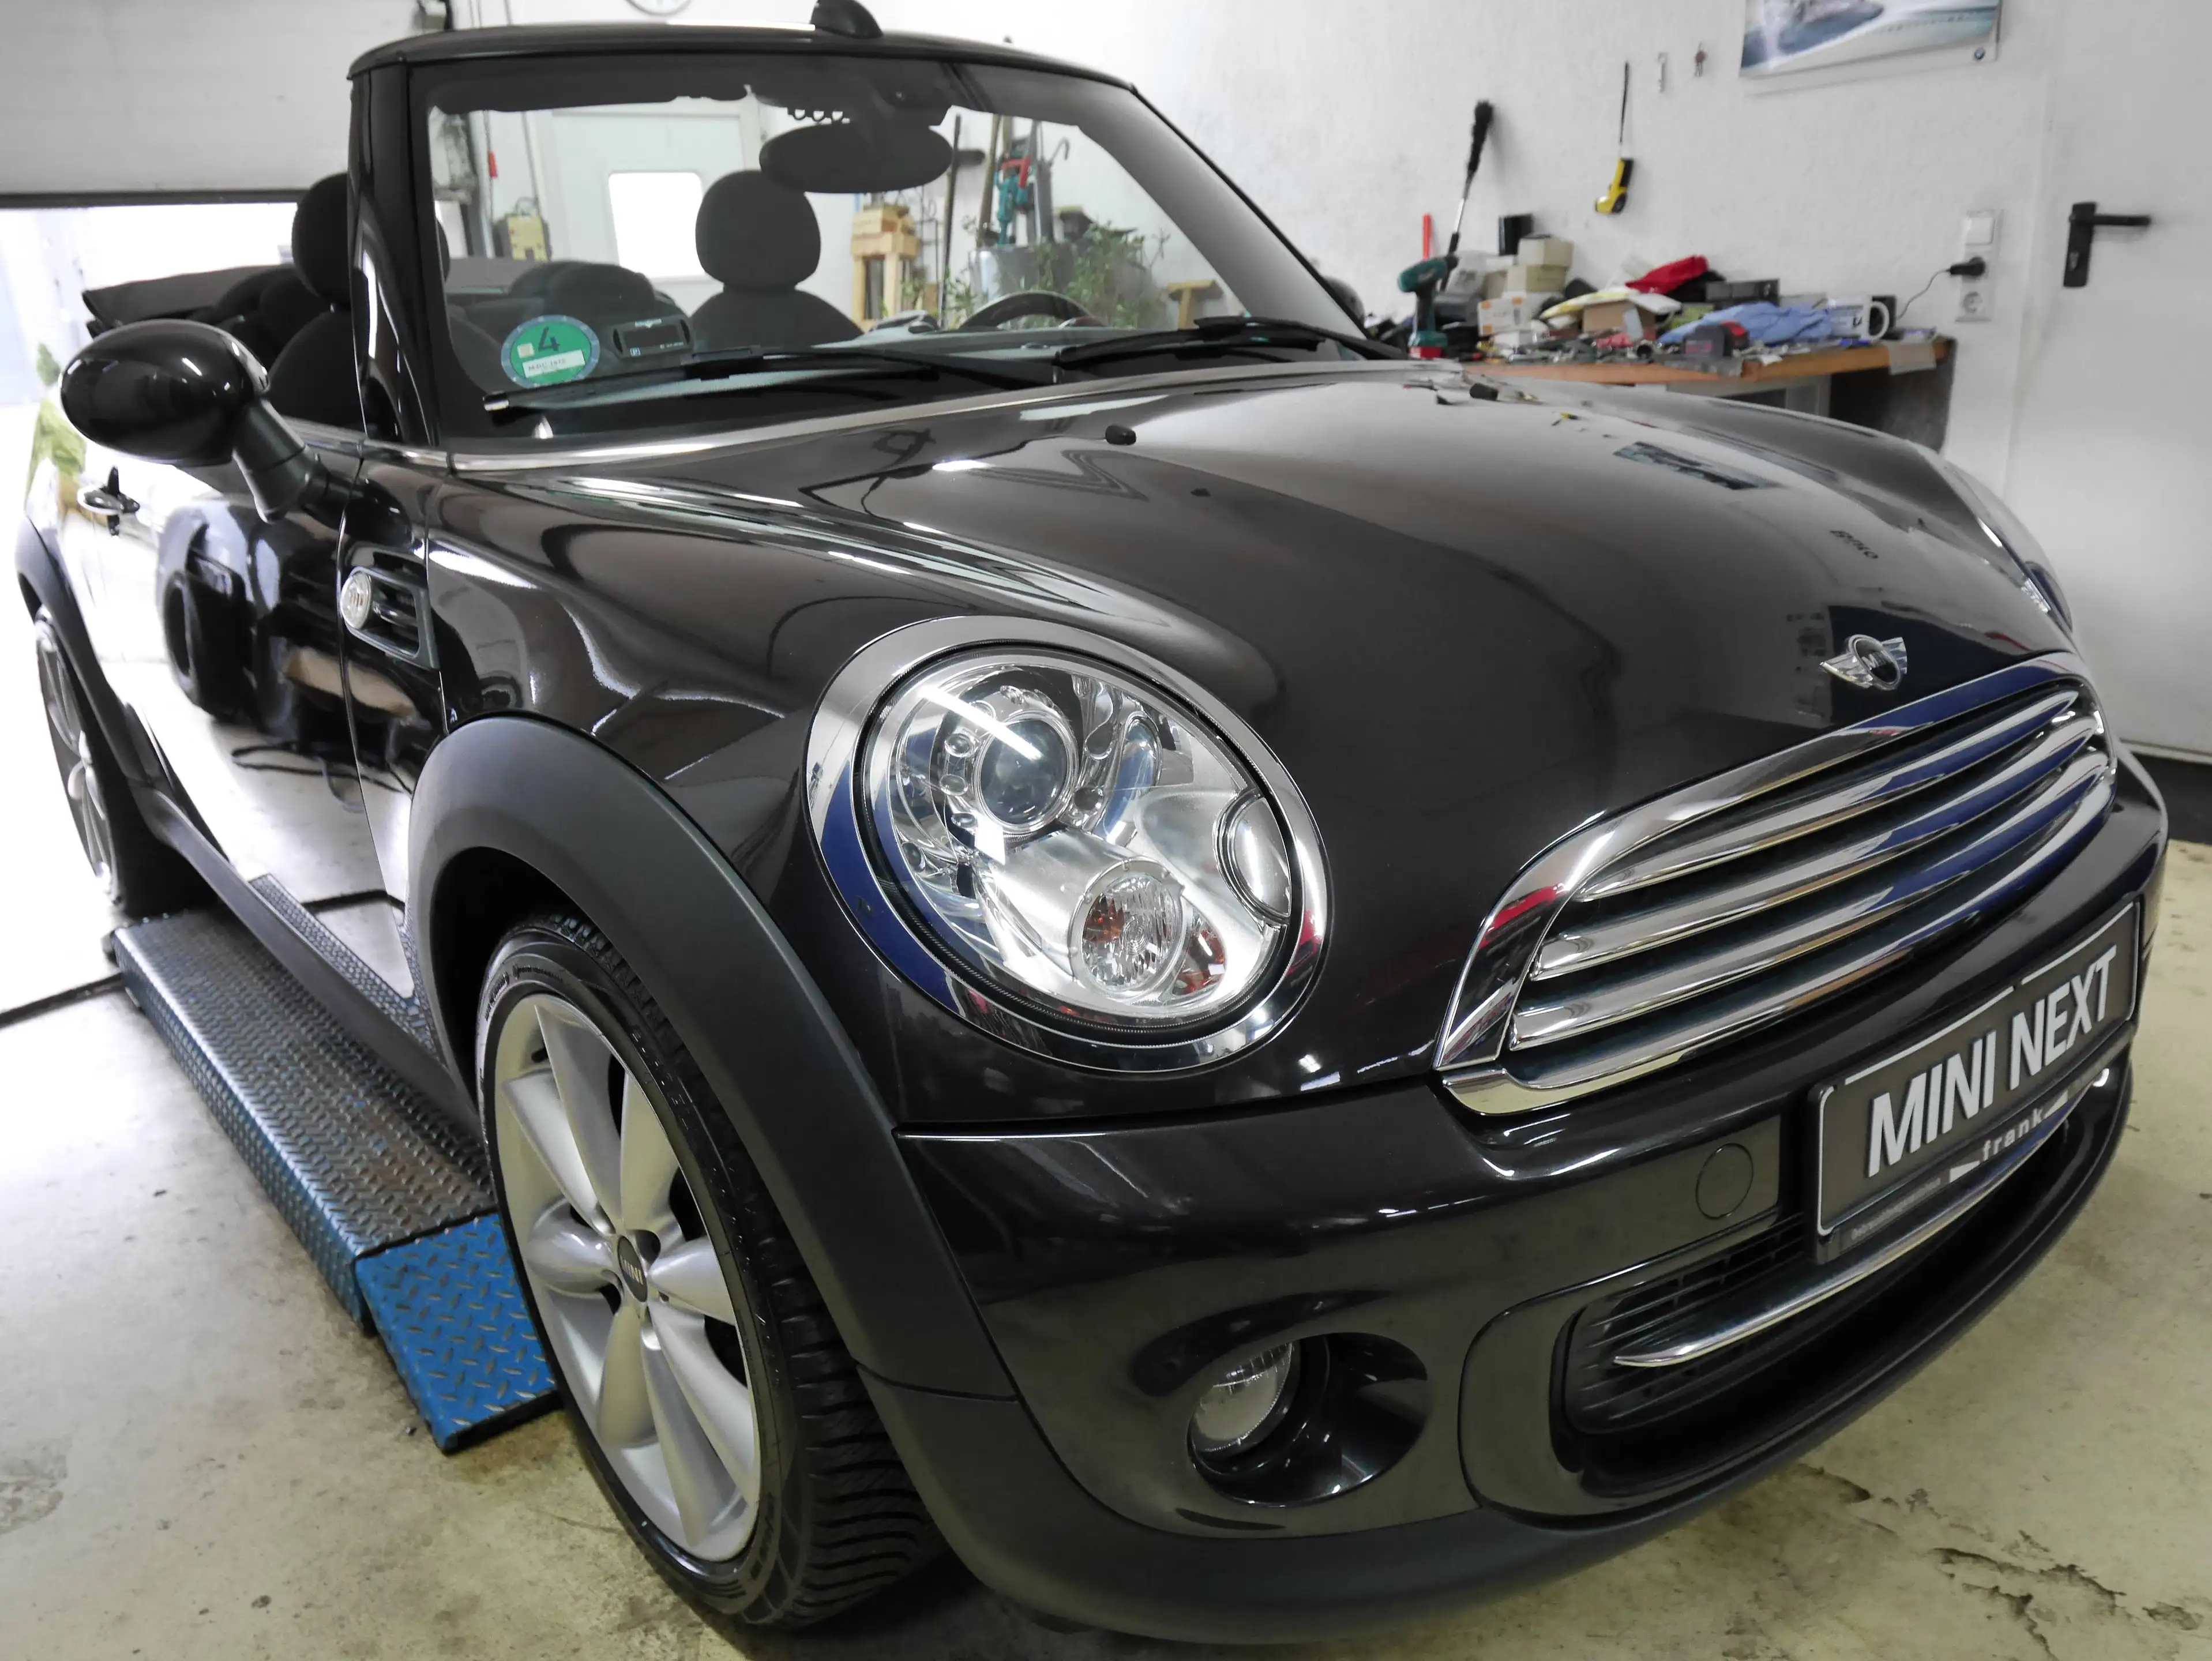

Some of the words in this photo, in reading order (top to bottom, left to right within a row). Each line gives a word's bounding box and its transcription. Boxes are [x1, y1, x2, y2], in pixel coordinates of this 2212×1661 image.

[538, 326, 560, 352] 4
[1868, 1029, 1996, 1178] MINI
[2010, 945, 2117, 1091] NEXT
[1982, 1108, 2043, 1162] frank
